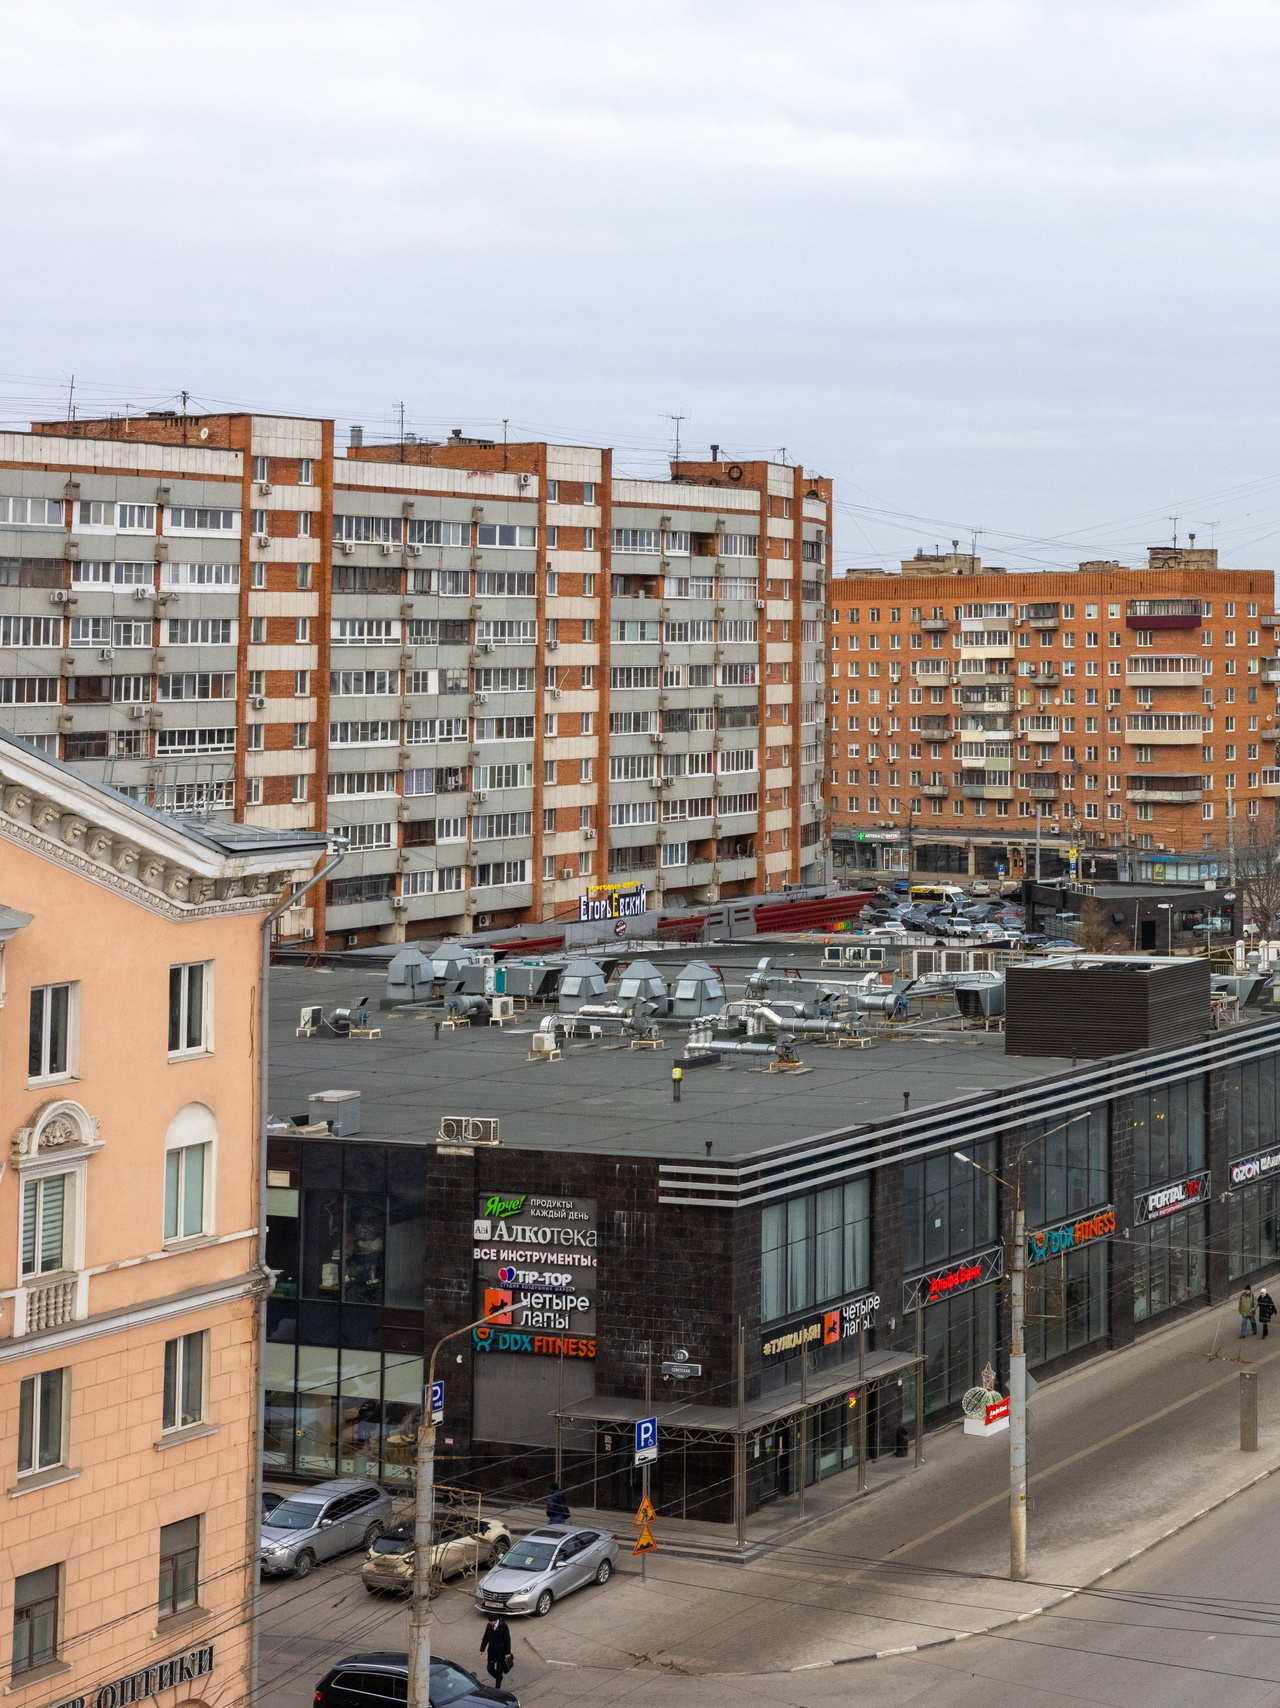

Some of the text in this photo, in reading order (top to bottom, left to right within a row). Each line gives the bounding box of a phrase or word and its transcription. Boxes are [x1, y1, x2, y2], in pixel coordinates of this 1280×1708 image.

[1231, 1160, 1260, 1182] OZON
[484, 1195, 527, 1218] Ярче!
[530, 1198, 573, 1209] ПРОДУКТЫ
[1149, 1185, 1186, 1211] PORTAL
[530, 1208, 589, 1220] КАЖДЫЙ ДЕНЬ
[1074, 1211, 1116, 1244] FITNESS
[473, 1248, 592, 1267] ВСЕ ИНСТРУМЕНТЫ
[930, 1265, 982, 1295] Альфа Банк
[499, 1333, 596, 1358] DDX FITNESS
[641, 1422, 653, 1447] P
[97, 1643, 214, 1708] ОПТИКИ
